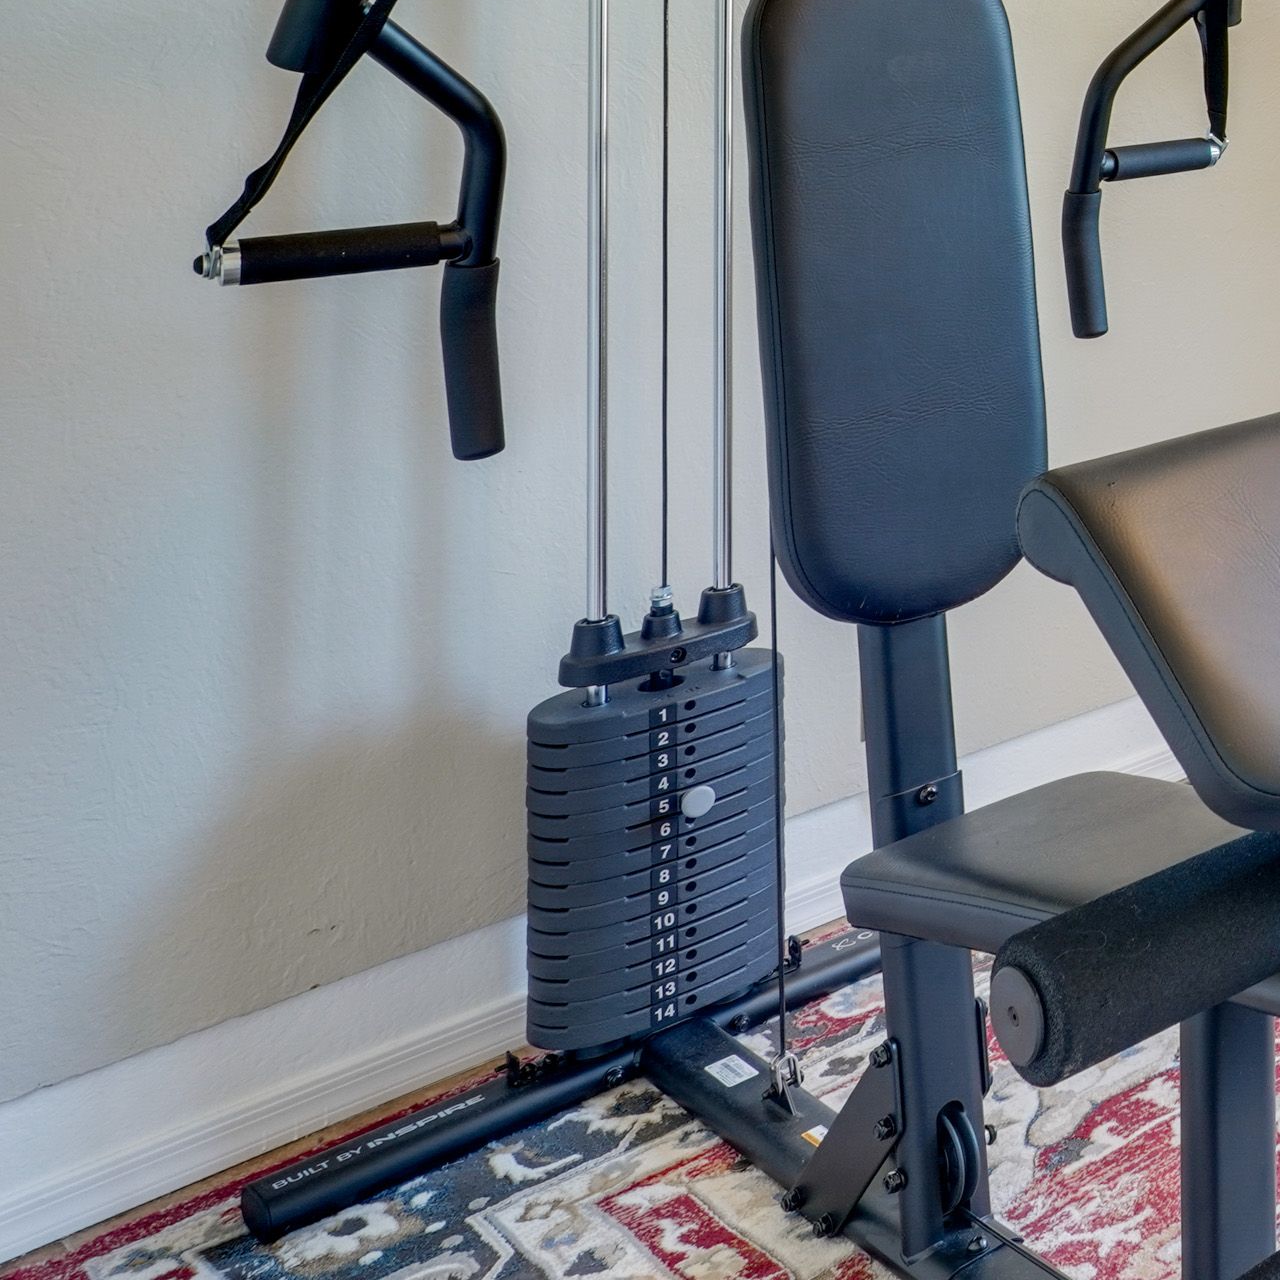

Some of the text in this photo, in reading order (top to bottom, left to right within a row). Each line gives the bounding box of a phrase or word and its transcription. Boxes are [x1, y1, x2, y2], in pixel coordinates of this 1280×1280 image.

[659, 708, 667, 722] 1
[658, 732, 669, 746] 2
[657, 754, 669, 767] 3
[658, 777, 669, 790] 4
[659, 799, 670, 813] 5
[660, 822, 671, 837] 6
[660, 844, 671, 859] 7
[659, 869, 670, 883] 8
[658, 891, 669, 905] 9
[654, 912, 675, 930] 10
[656, 934, 675, 952] 11
[655, 958, 676, 976] 12
[655, 981, 676, 999] 13
[654, 1003, 676, 1022] 14
[271, 1094, 486, 1190] BUILT BY INSPIRE
